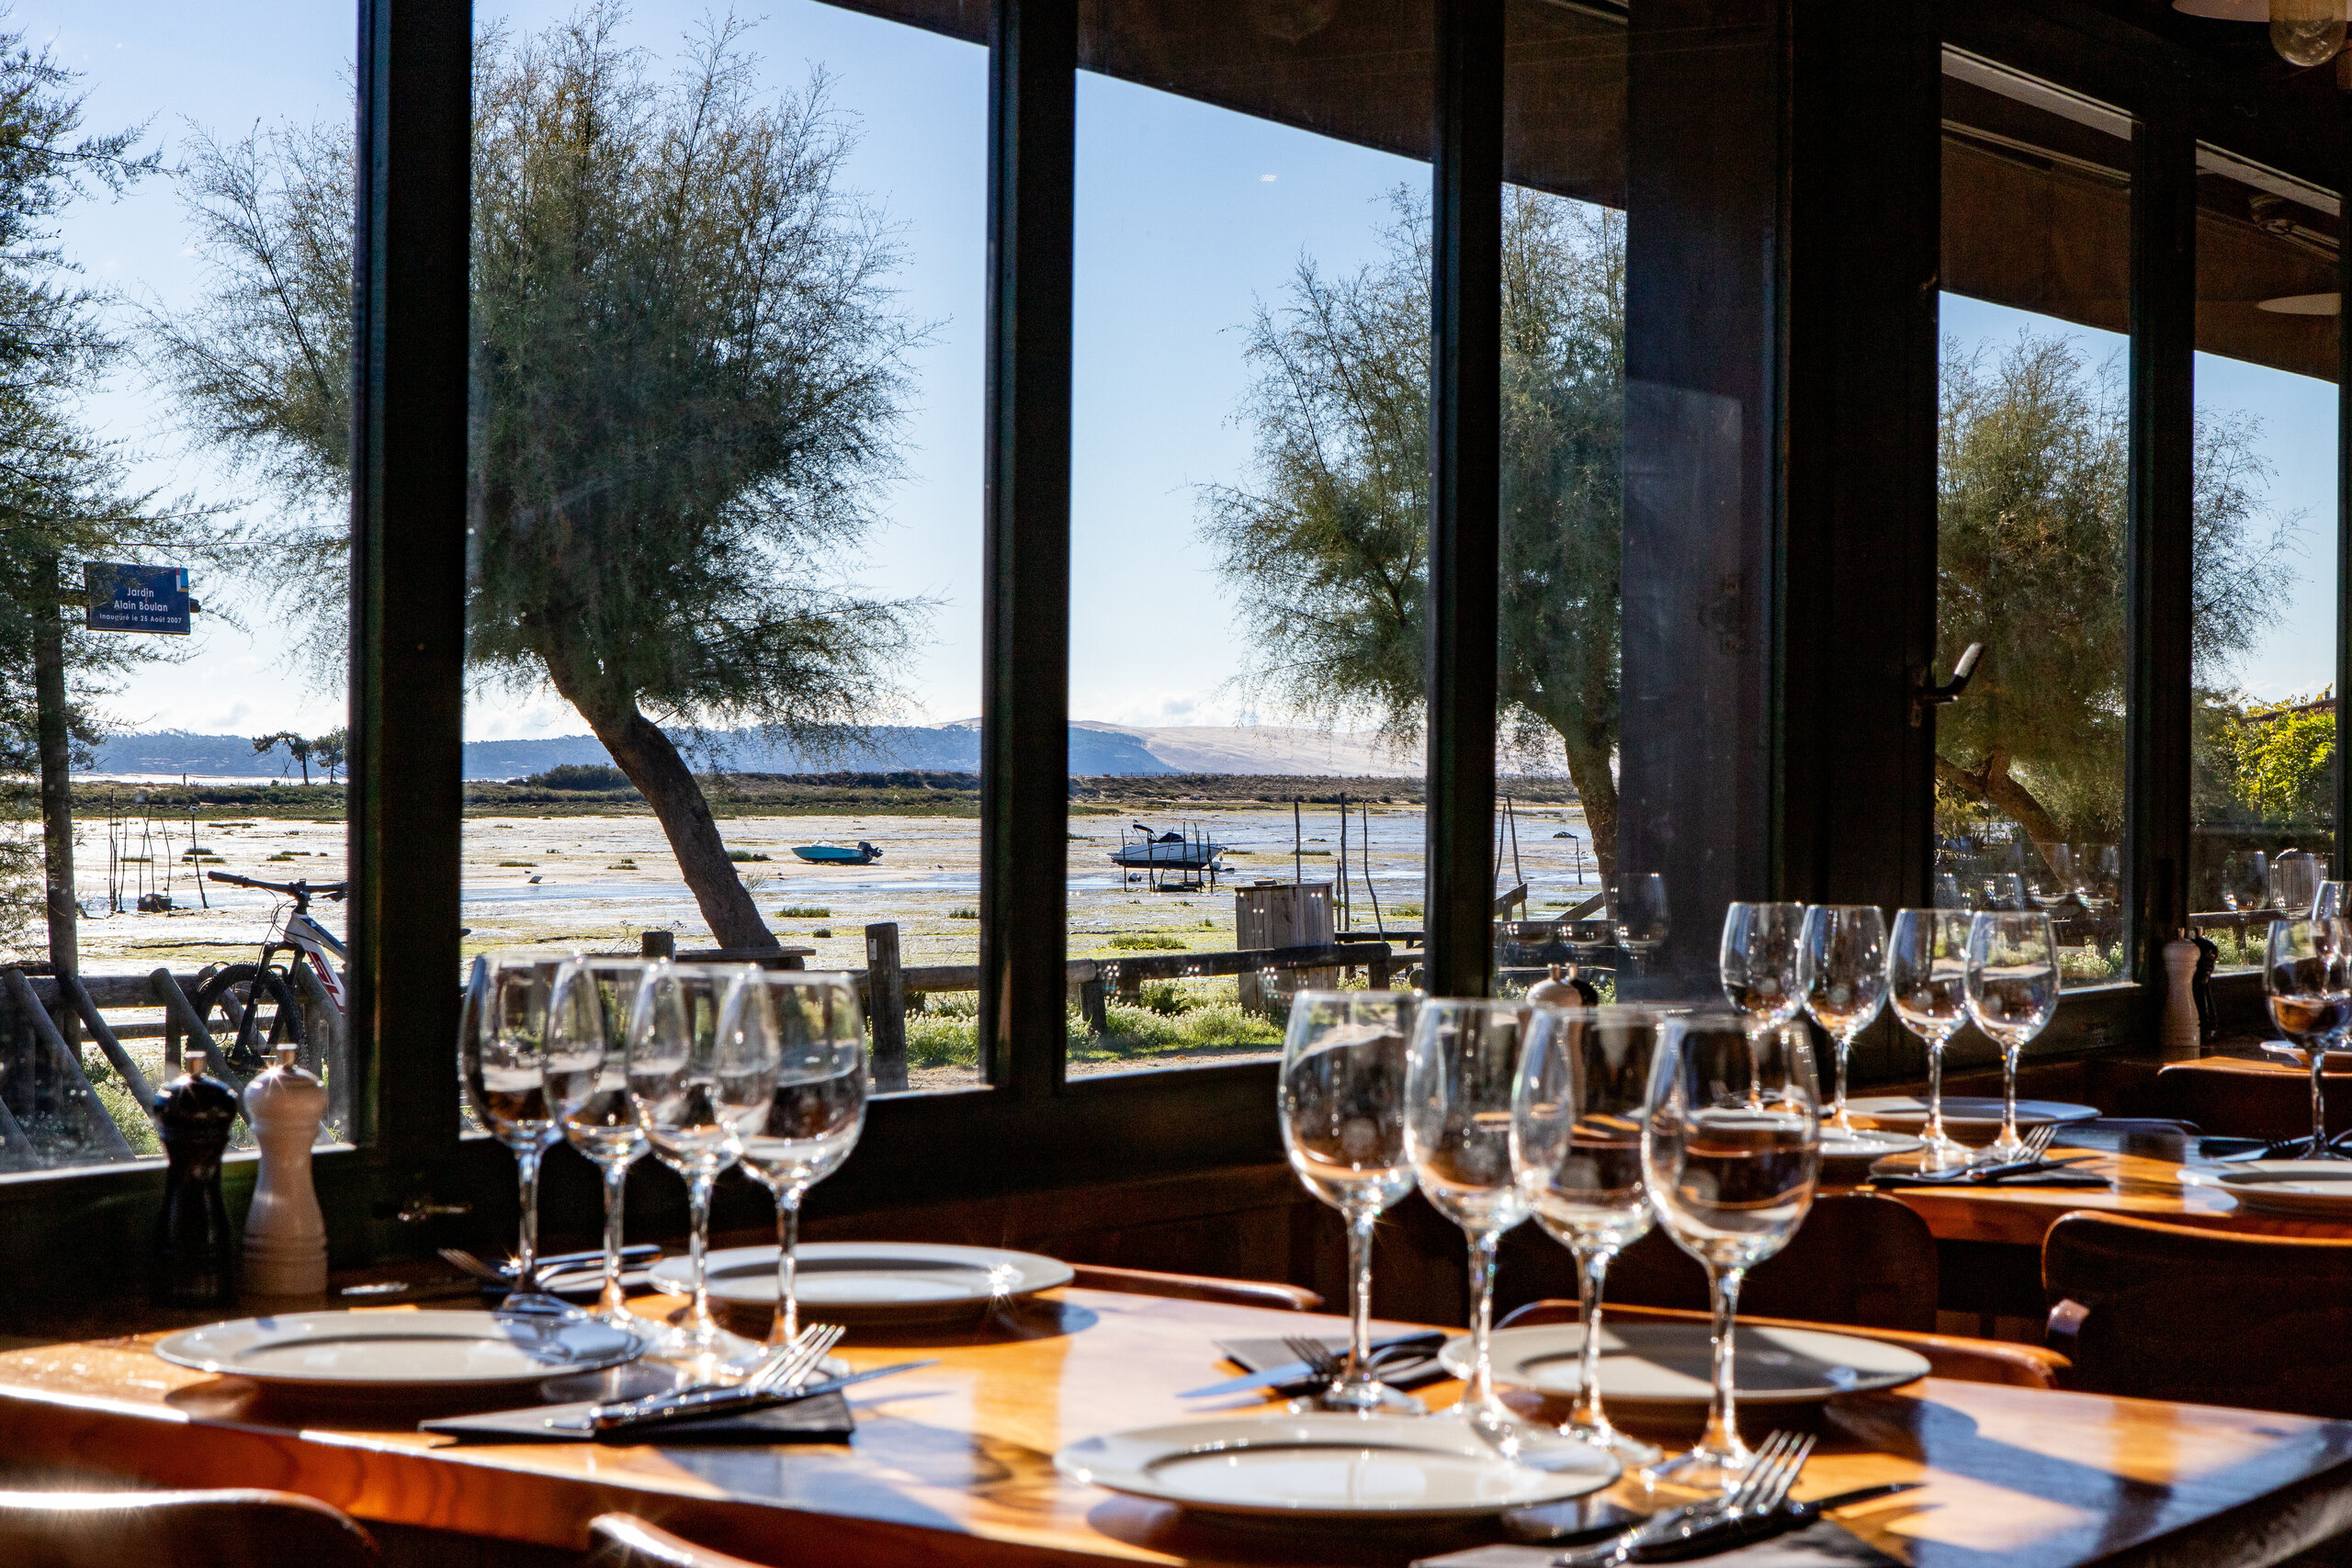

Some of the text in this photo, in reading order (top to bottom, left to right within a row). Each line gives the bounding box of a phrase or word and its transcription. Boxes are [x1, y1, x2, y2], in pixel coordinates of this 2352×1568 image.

[127, 588, 154, 597] Jardin
[114, 600, 168, 612] Alain Boulan
